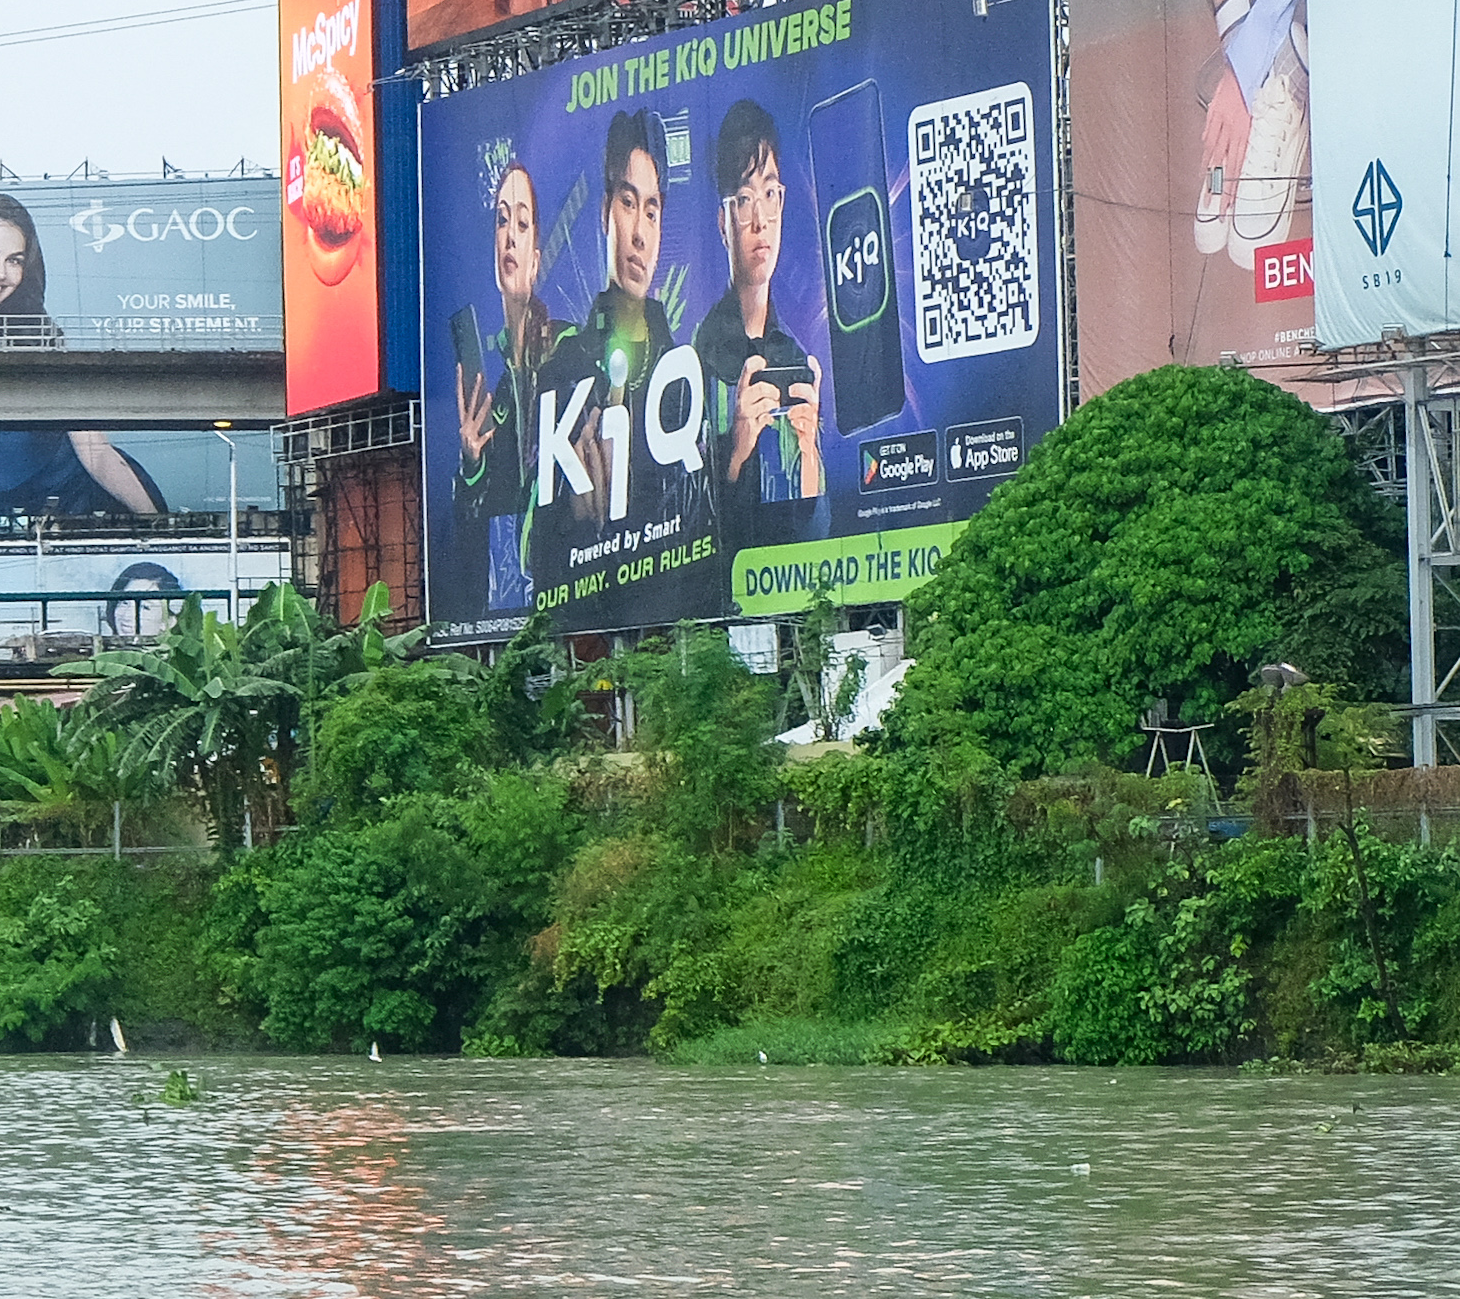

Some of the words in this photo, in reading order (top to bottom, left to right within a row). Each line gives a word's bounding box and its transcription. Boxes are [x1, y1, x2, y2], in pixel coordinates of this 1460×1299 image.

[566, 63, 618, 114] JOIN
[624, 48, 670, 97] THE
[675, 37, 717, 84] KiQ
[127, 205, 259, 242] GAOC
[836, 231, 880, 286] KiQ
[1361, 268, 1403, 290] SB19
[117, 294, 171, 311] YOUR
[174, 293, 236, 311] SMILE,
[91, 317, 145, 334] YOUR
[149, 316, 262, 334] STATEMENT.
[1239, 350, 1257, 364] HOP
[1258, 347, 1292, 362] ONLINE
[538, 344, 705, 522] KiQ
[965, 432, 996, 446] Download
[1004, 430, 1016, 440] the
[880, 456, 914, 482] Google
[914, 453, 935, 478] Play
[965, 448, 989, 471] App
[989, 445, 1019, 465] Store
[570, 533, 620, 568] Powered
[623, 530, 640, 552] by
[643, 514, 681, 543] Smart
[536, 584, 569, 612] OUR
[575, 570, 610, 600] WAY.
[617, 557, 654, 586] OUR
[659, 534, 717, 574] RULES.
[745, 555, 859, 597] DOWNLOAD
[865, 551, 901, 583] THE
